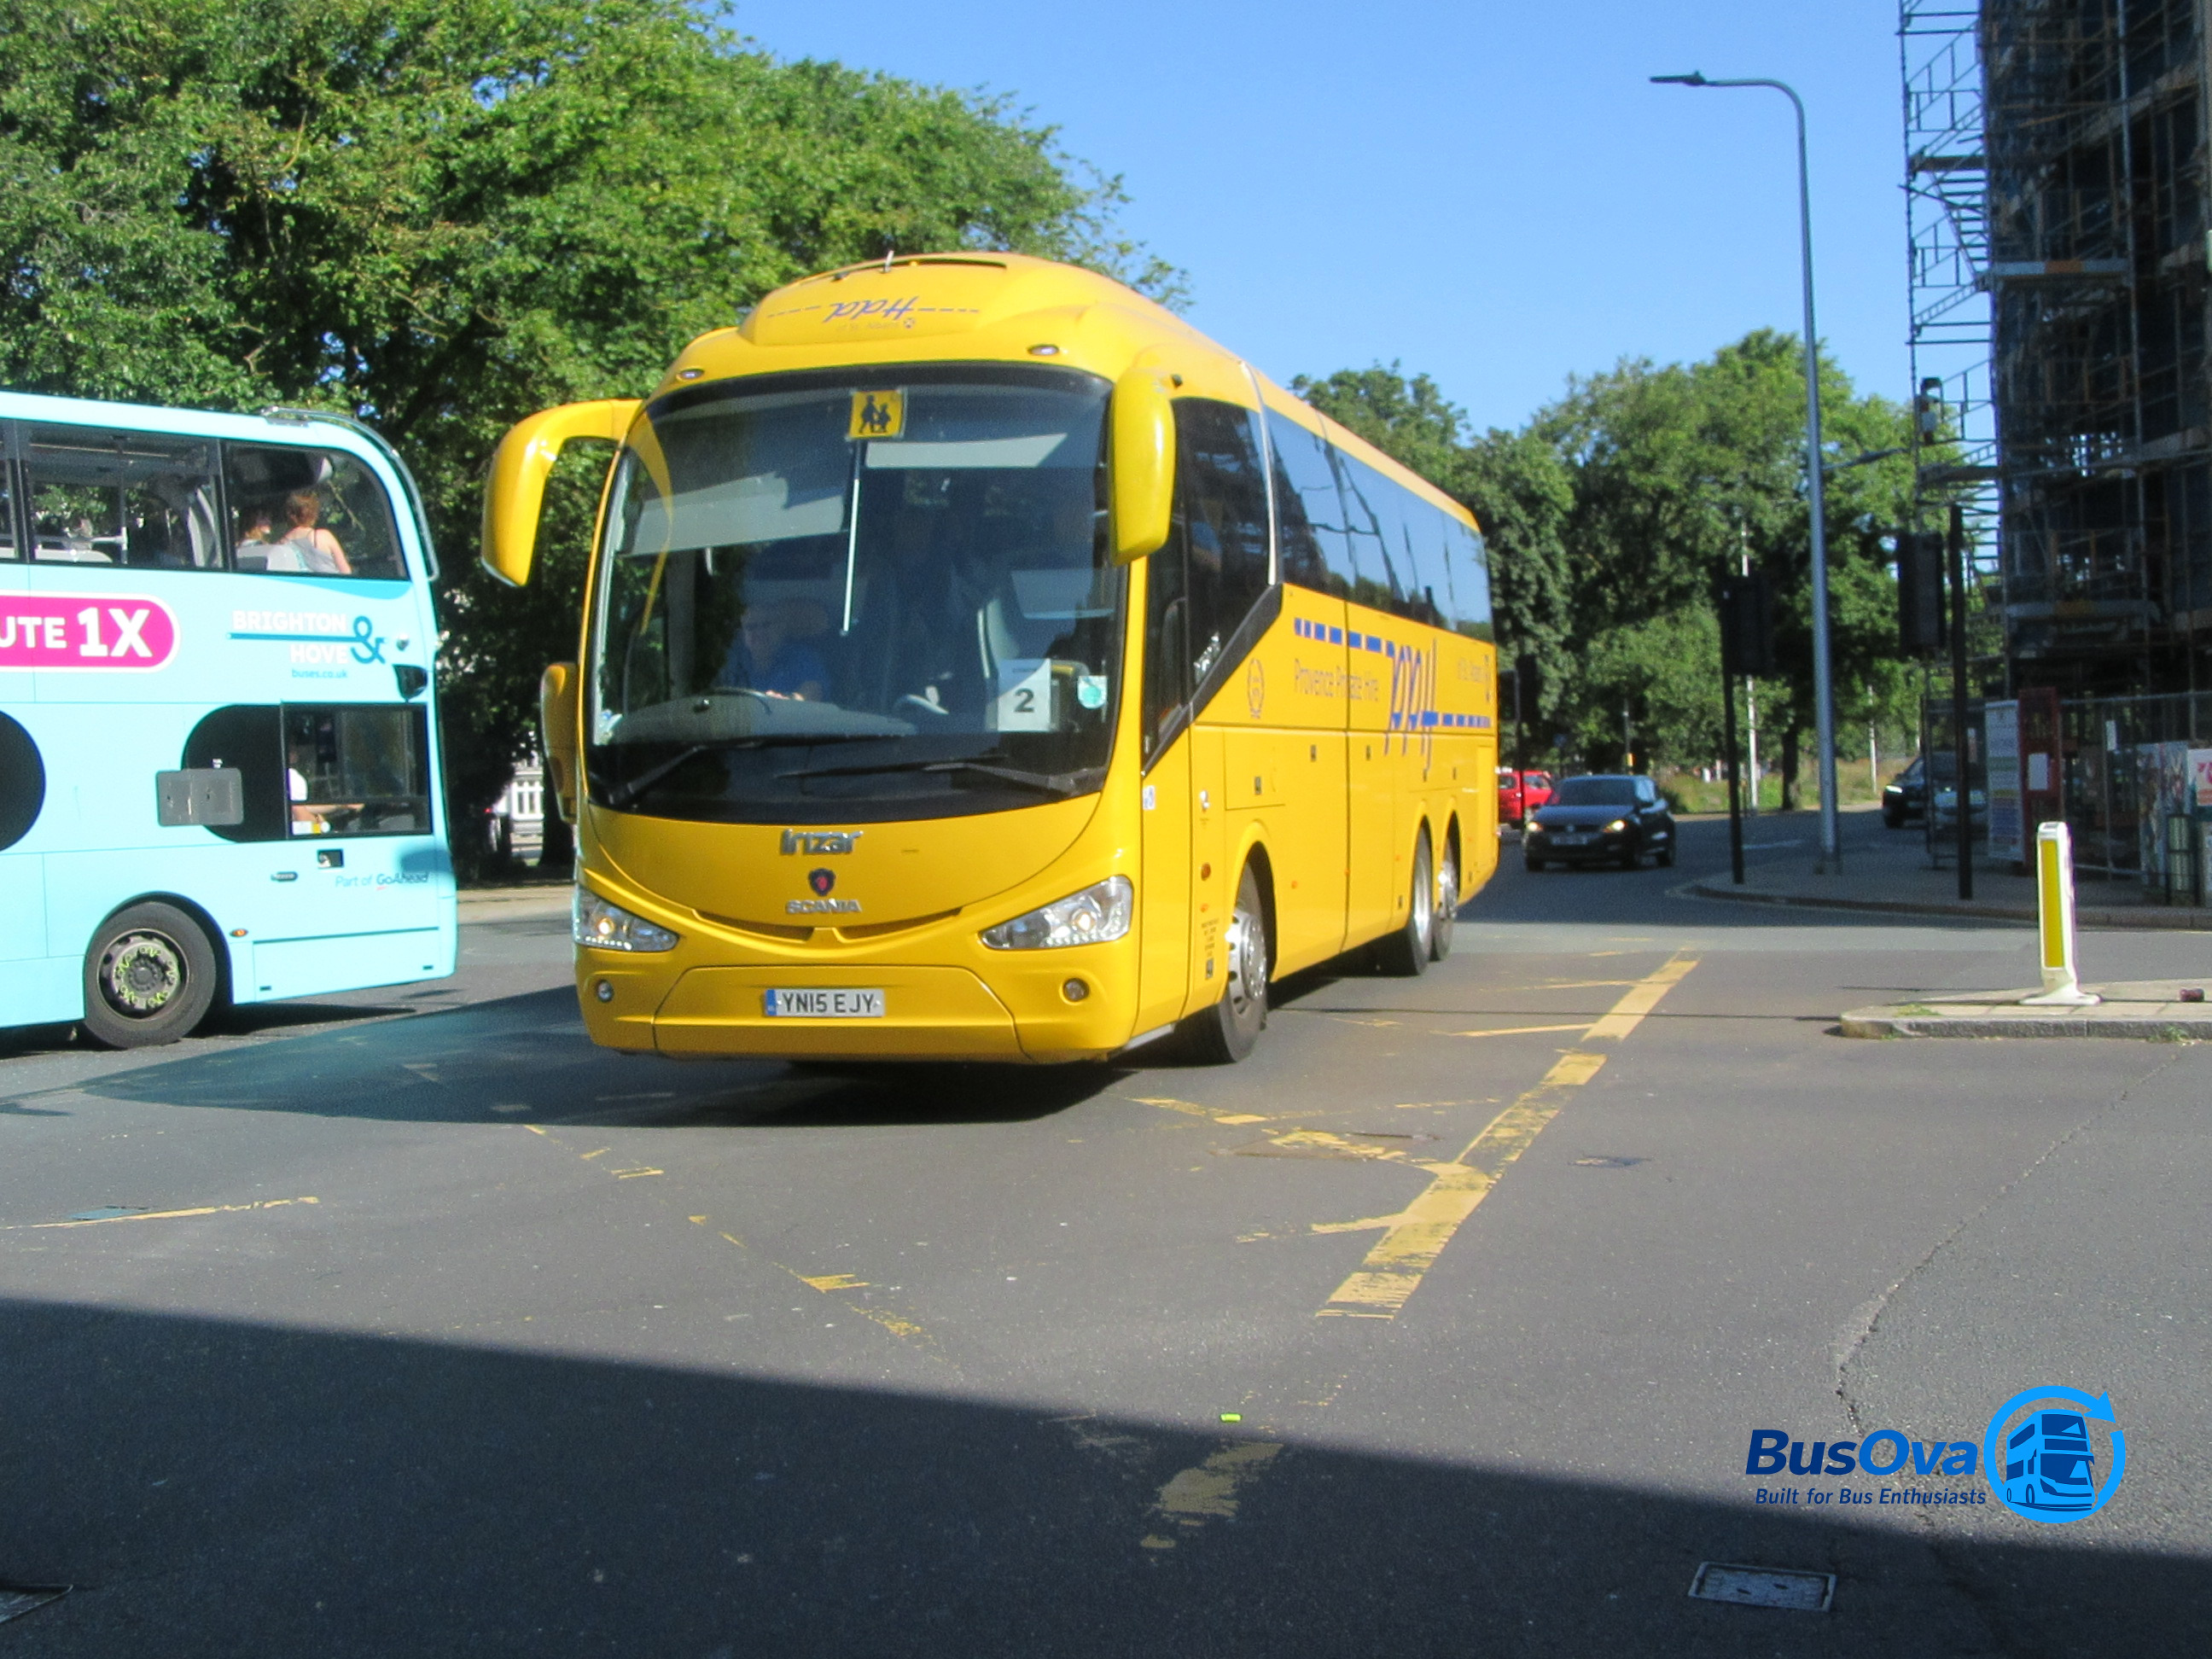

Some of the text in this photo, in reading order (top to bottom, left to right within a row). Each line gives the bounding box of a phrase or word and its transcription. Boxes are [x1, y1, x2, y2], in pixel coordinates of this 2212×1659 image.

[232, 610, 347, 632] BRIGHTON
[77, 607, 154, 658] 1X
[289, 643, 348, 664] HOVE
[291, 668, 348, 678] buses.co.uk
[1294, 657, 1334, 696] Provence
[1014, 687, 1035, 713] 2
[335, 874, 358, 887] Part
[362, 873, 373, 886] of
[786, 899, 863, 914] SCANIA
[783, 992, 874, 1013] YN15 EJY
